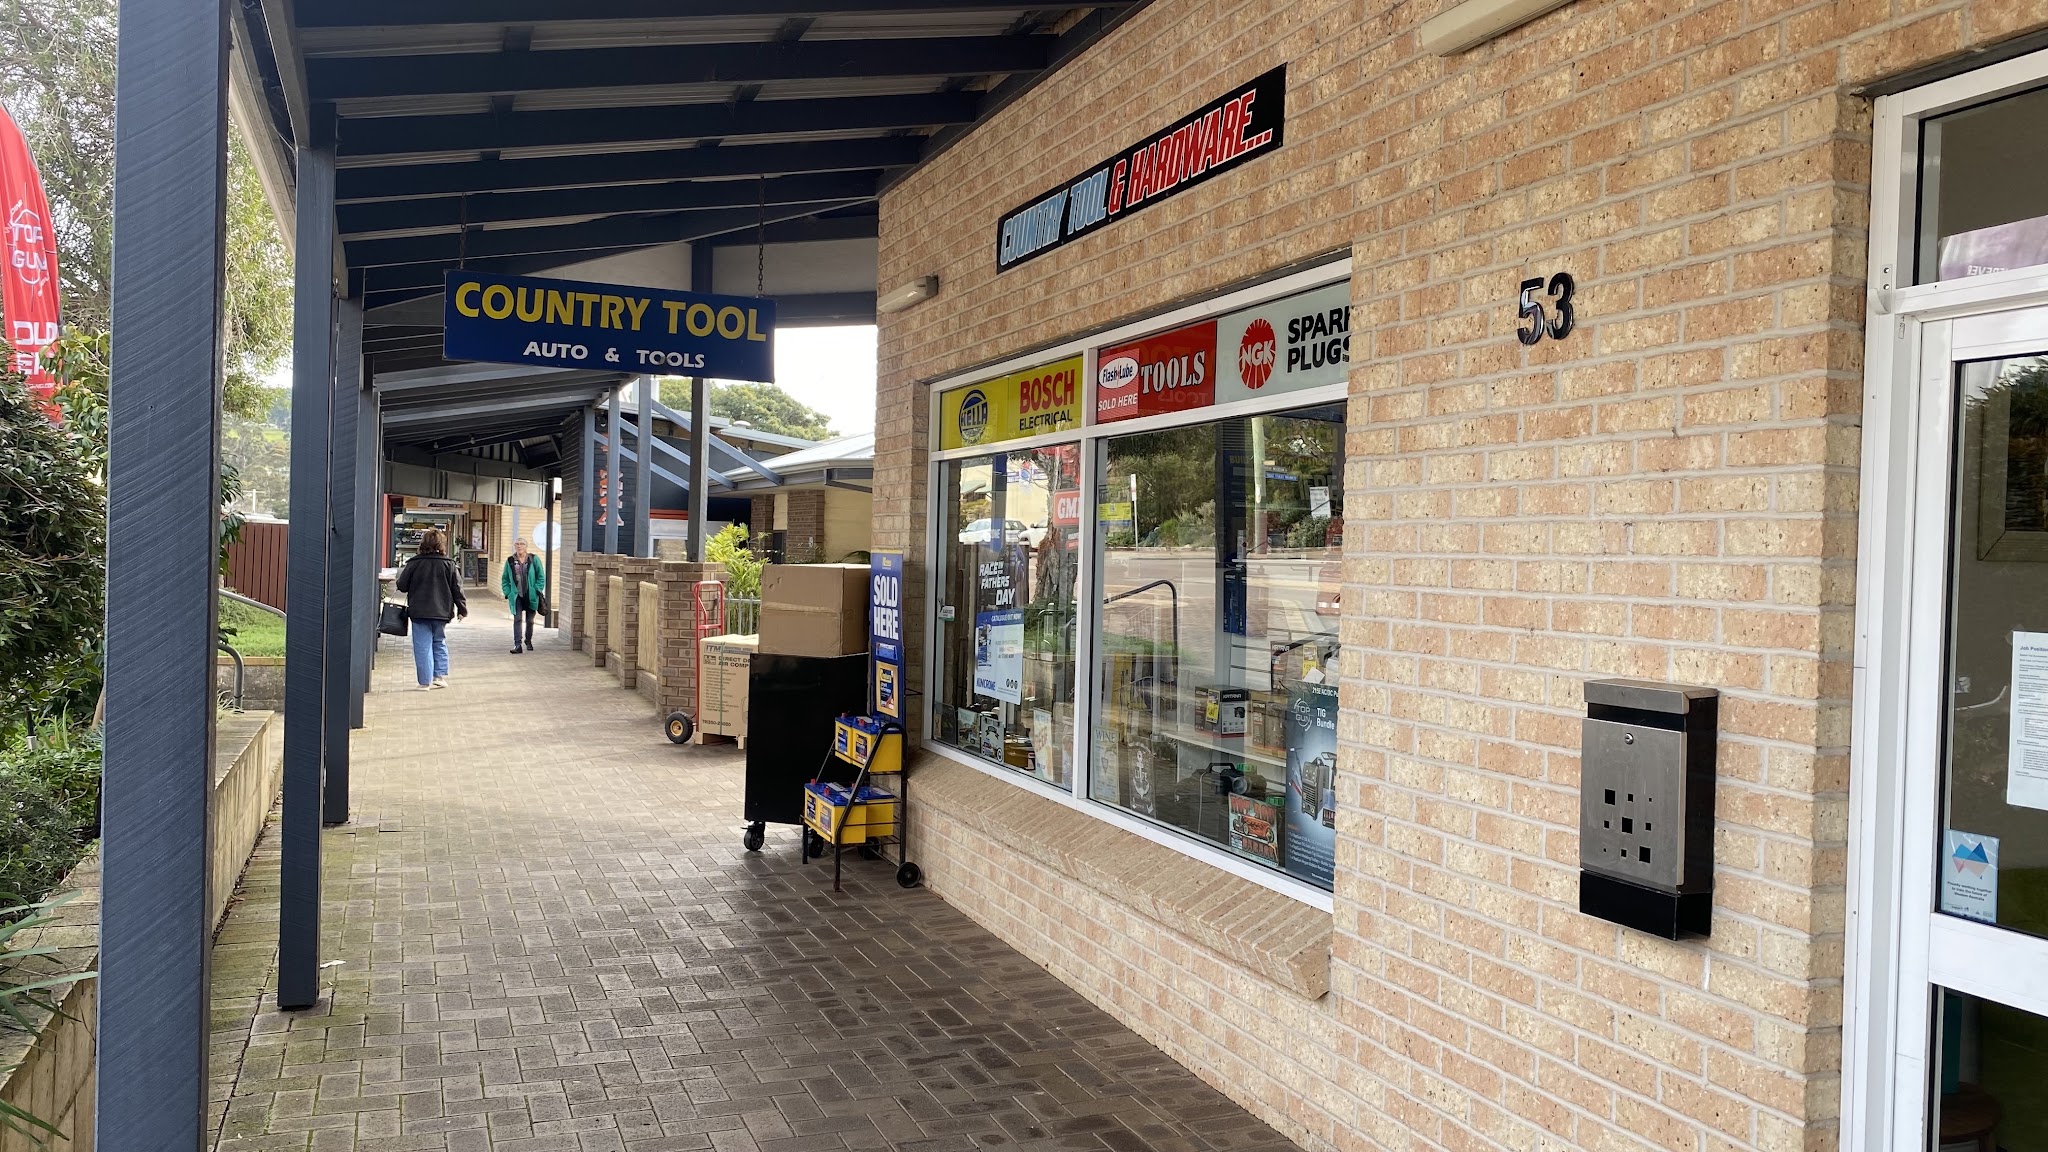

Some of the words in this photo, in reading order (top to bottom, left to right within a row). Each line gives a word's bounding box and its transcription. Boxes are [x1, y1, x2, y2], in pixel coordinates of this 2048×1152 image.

[1000, 187, 1069, 266] COUNTRY
[1067, 167, 1109, 236] TOOL
[1108, 158, 1127, 215] &
[11, 250, 47, 271] GUN
[455, 281, 651, 331] COUNTRY
[662, 300, 767, 342] TOOL
[1517, 272, 1574, 345] 53
[522, 341, 589, 360] AUTO
[604, 347, 620, 363] &
[636, 349, 705, 369] TOOLS
[1241, 340, 1274, 370] NGK
[1140, 350, 1205, 394] TOOLS
[1020, 369, 1075, 414] BOSCH
[1098, 397, 1116, 412] SOLD
[1117, 393, 1138, 407] HERE
[961, 402, 987, 426] HELLA
[1020, 409, 1072, 431] ELECTRICAL
[1058, 496, 1080, 519] GM
[979, 561, 998, 577] RACE
[873, 574, 898, 607] SOLD
[981, 576, 1010, 589] FATHERS
[995, 588, 1016, 605] DAY
[873, 606, 899, 640] HERE
[976, 677, 996, 691] KINCROME
[1295, 714, 1311, 722] GUN
[1296, 705, 1311, 713] TOP
[1316, 708, 1326, 718] TIG
[1316, 718, 1335, 730] Bundle
[1095, 729, 1115, 743] WINE
